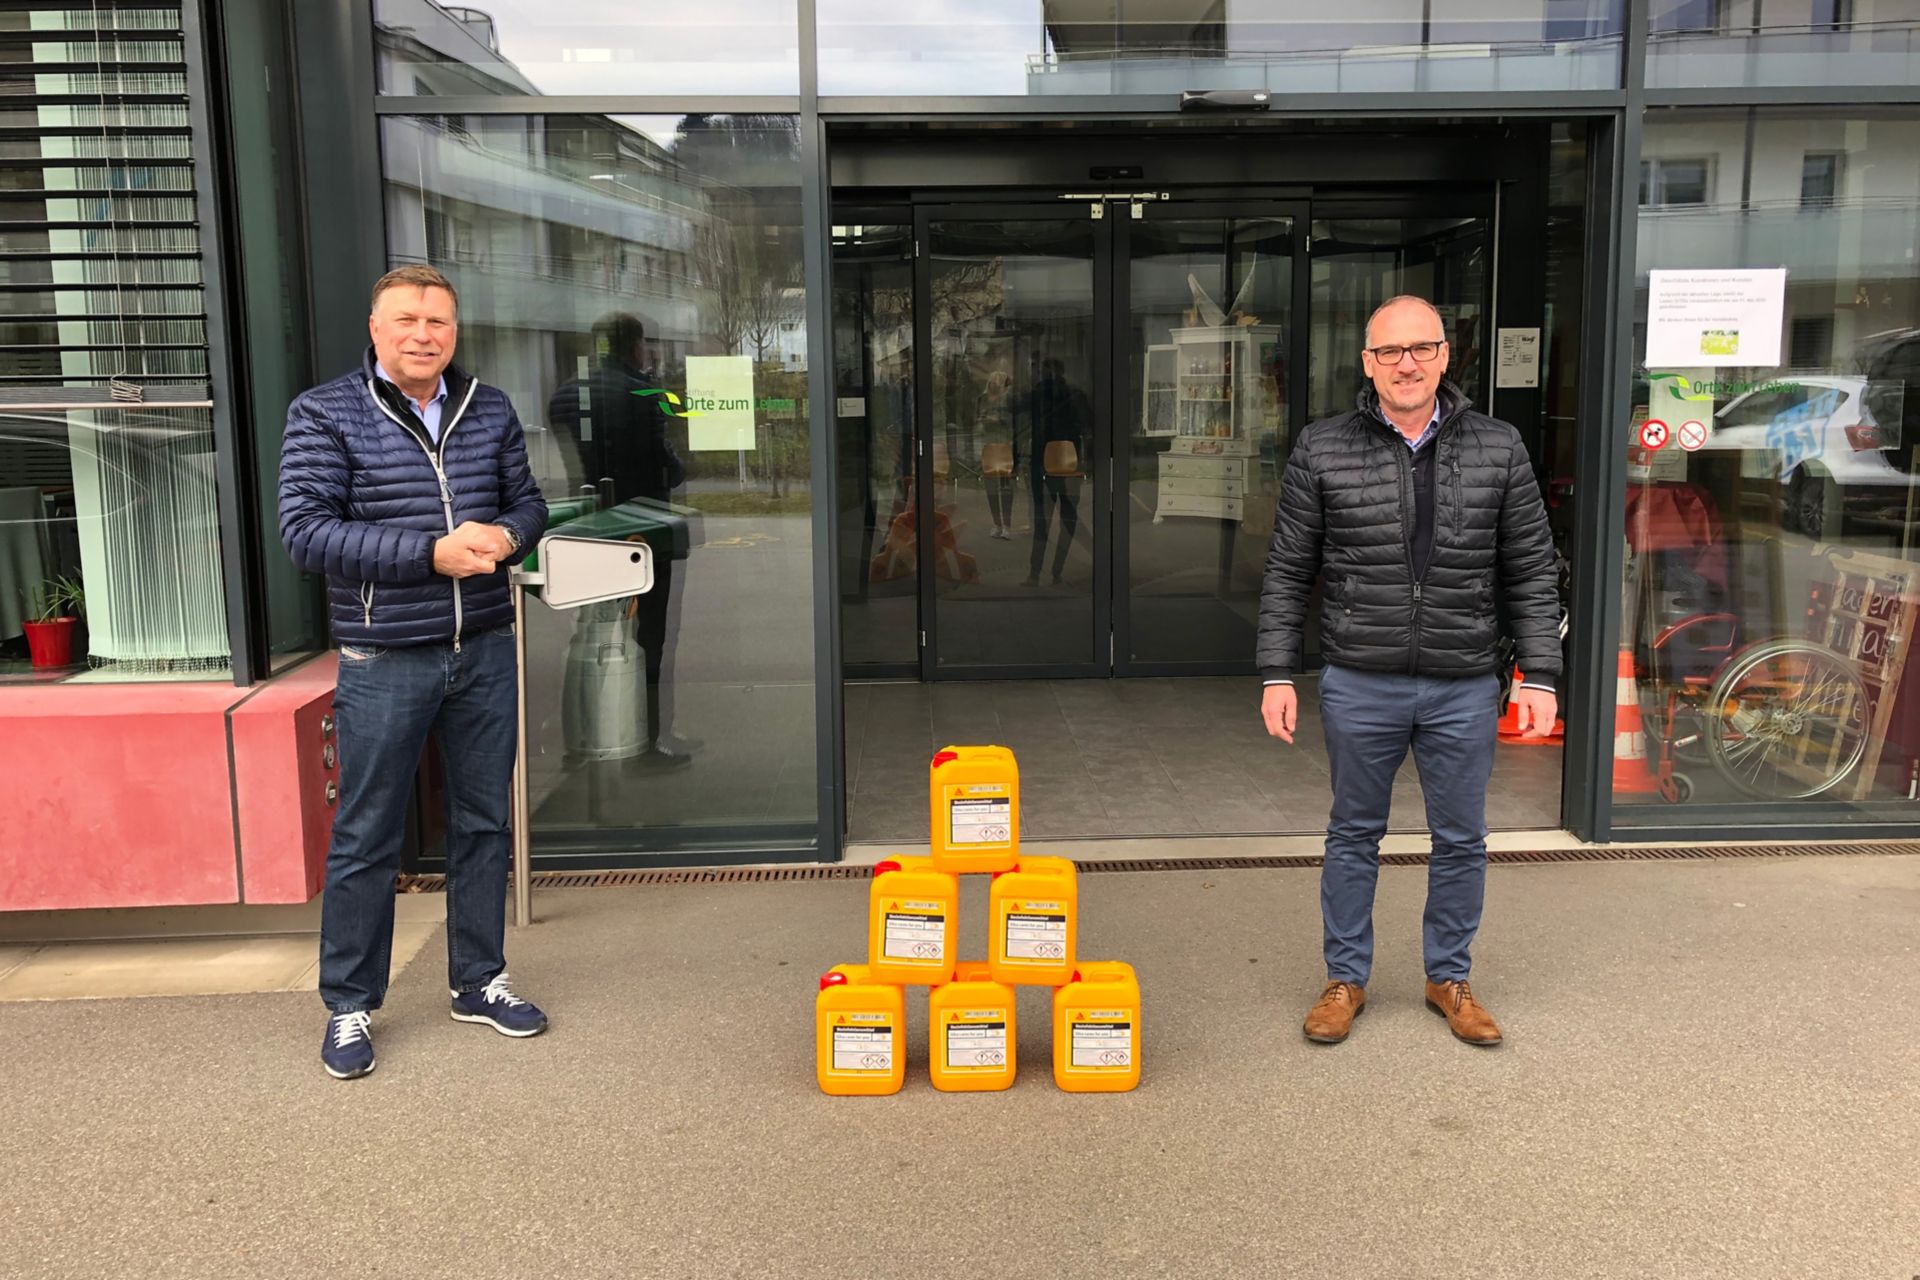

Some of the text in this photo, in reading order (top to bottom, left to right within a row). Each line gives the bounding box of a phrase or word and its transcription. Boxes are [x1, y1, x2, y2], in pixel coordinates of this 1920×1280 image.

[1694, 381, 1721, 394] Orte
[685, 397, 714, 410] Orte
[719, 399, 749, 410] zum
